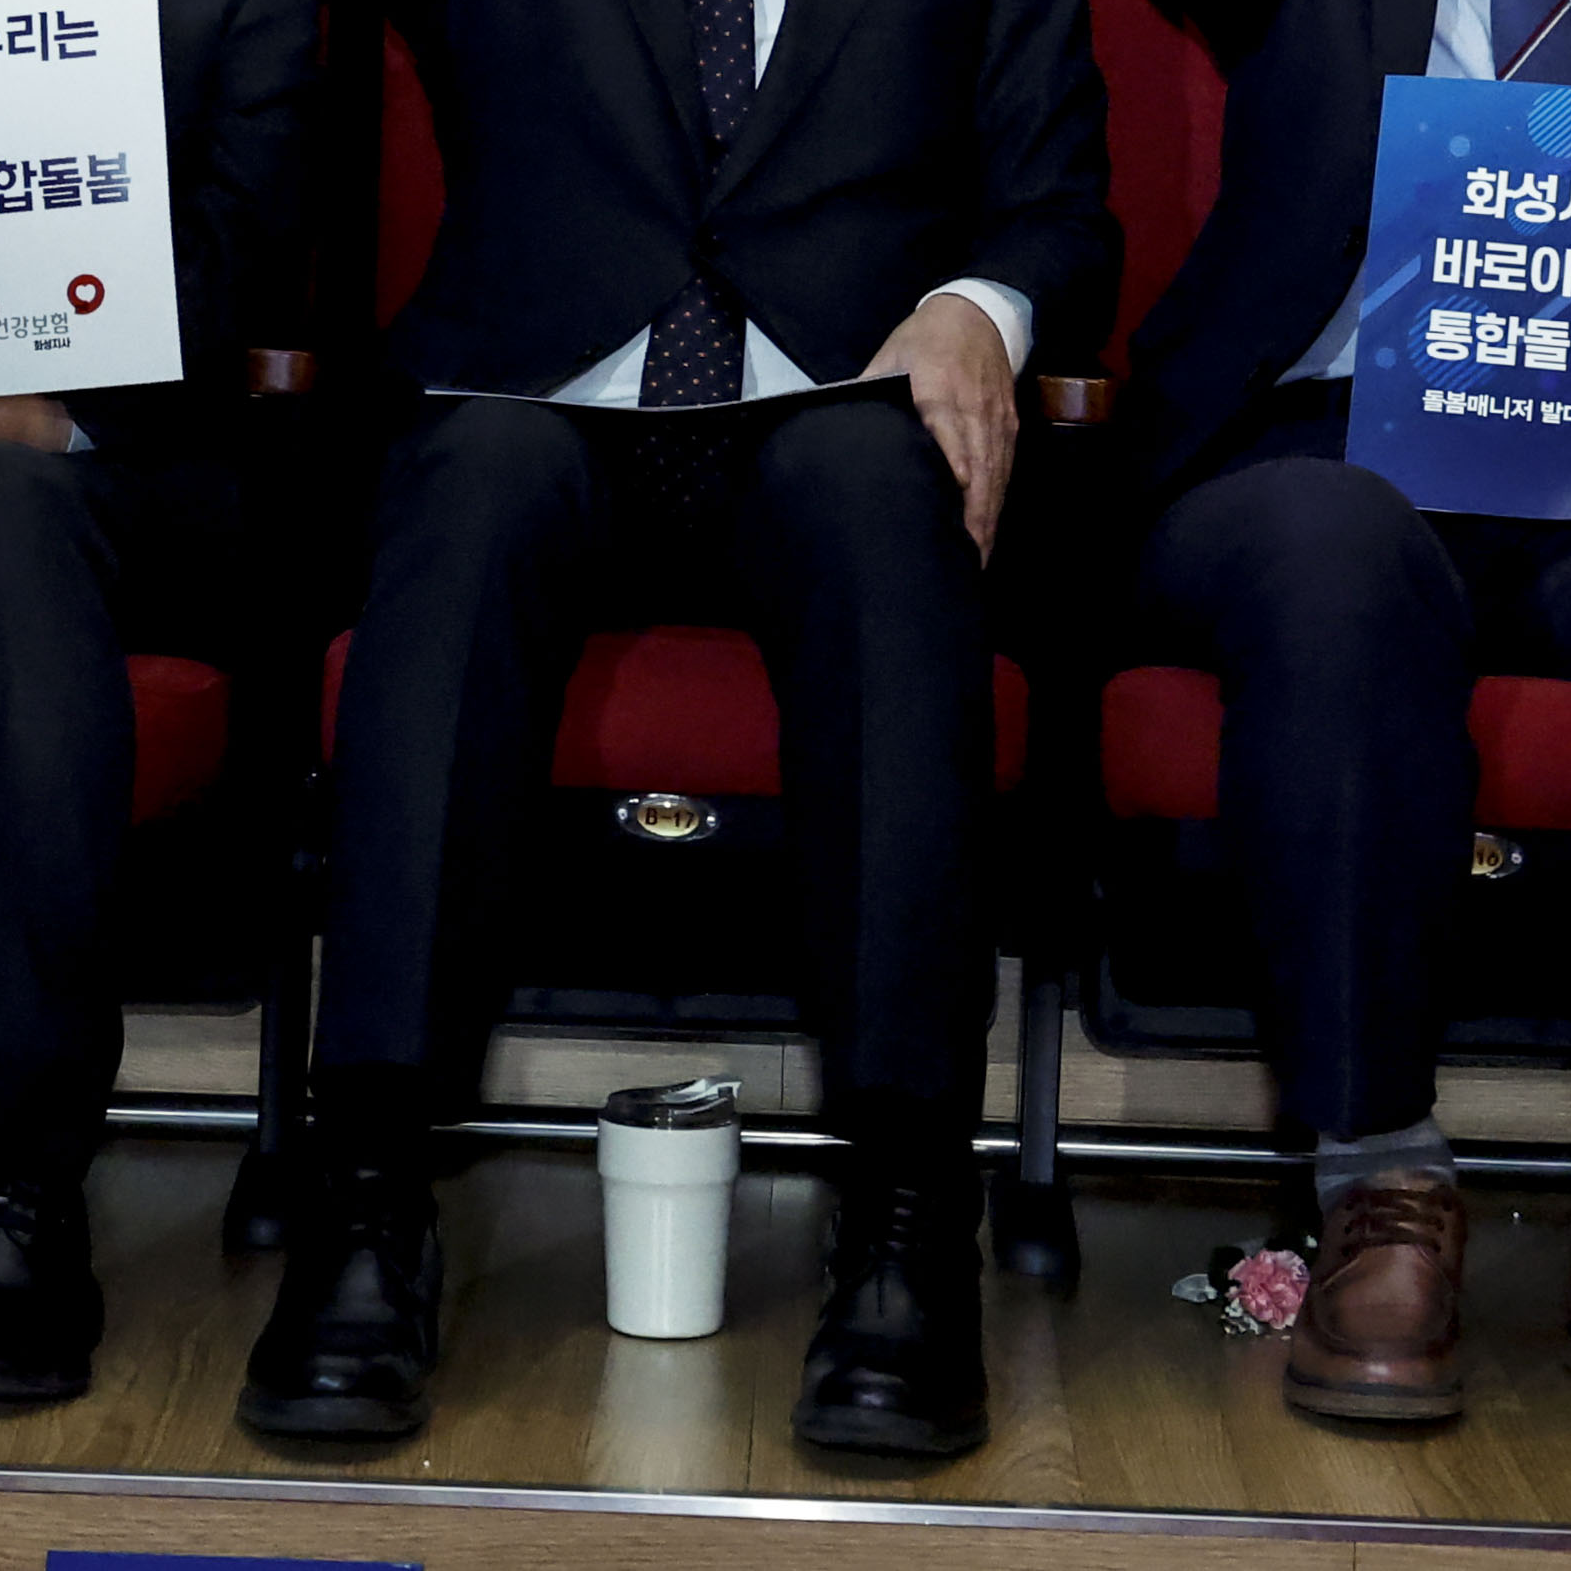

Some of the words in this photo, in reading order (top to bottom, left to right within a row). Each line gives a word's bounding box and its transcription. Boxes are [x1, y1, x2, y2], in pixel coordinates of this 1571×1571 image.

[34, 337, 71, 351] 화성지사
[1422, 389, 1534, 422] 돌봄매니저
[645, 806, 695, 829] B-17
